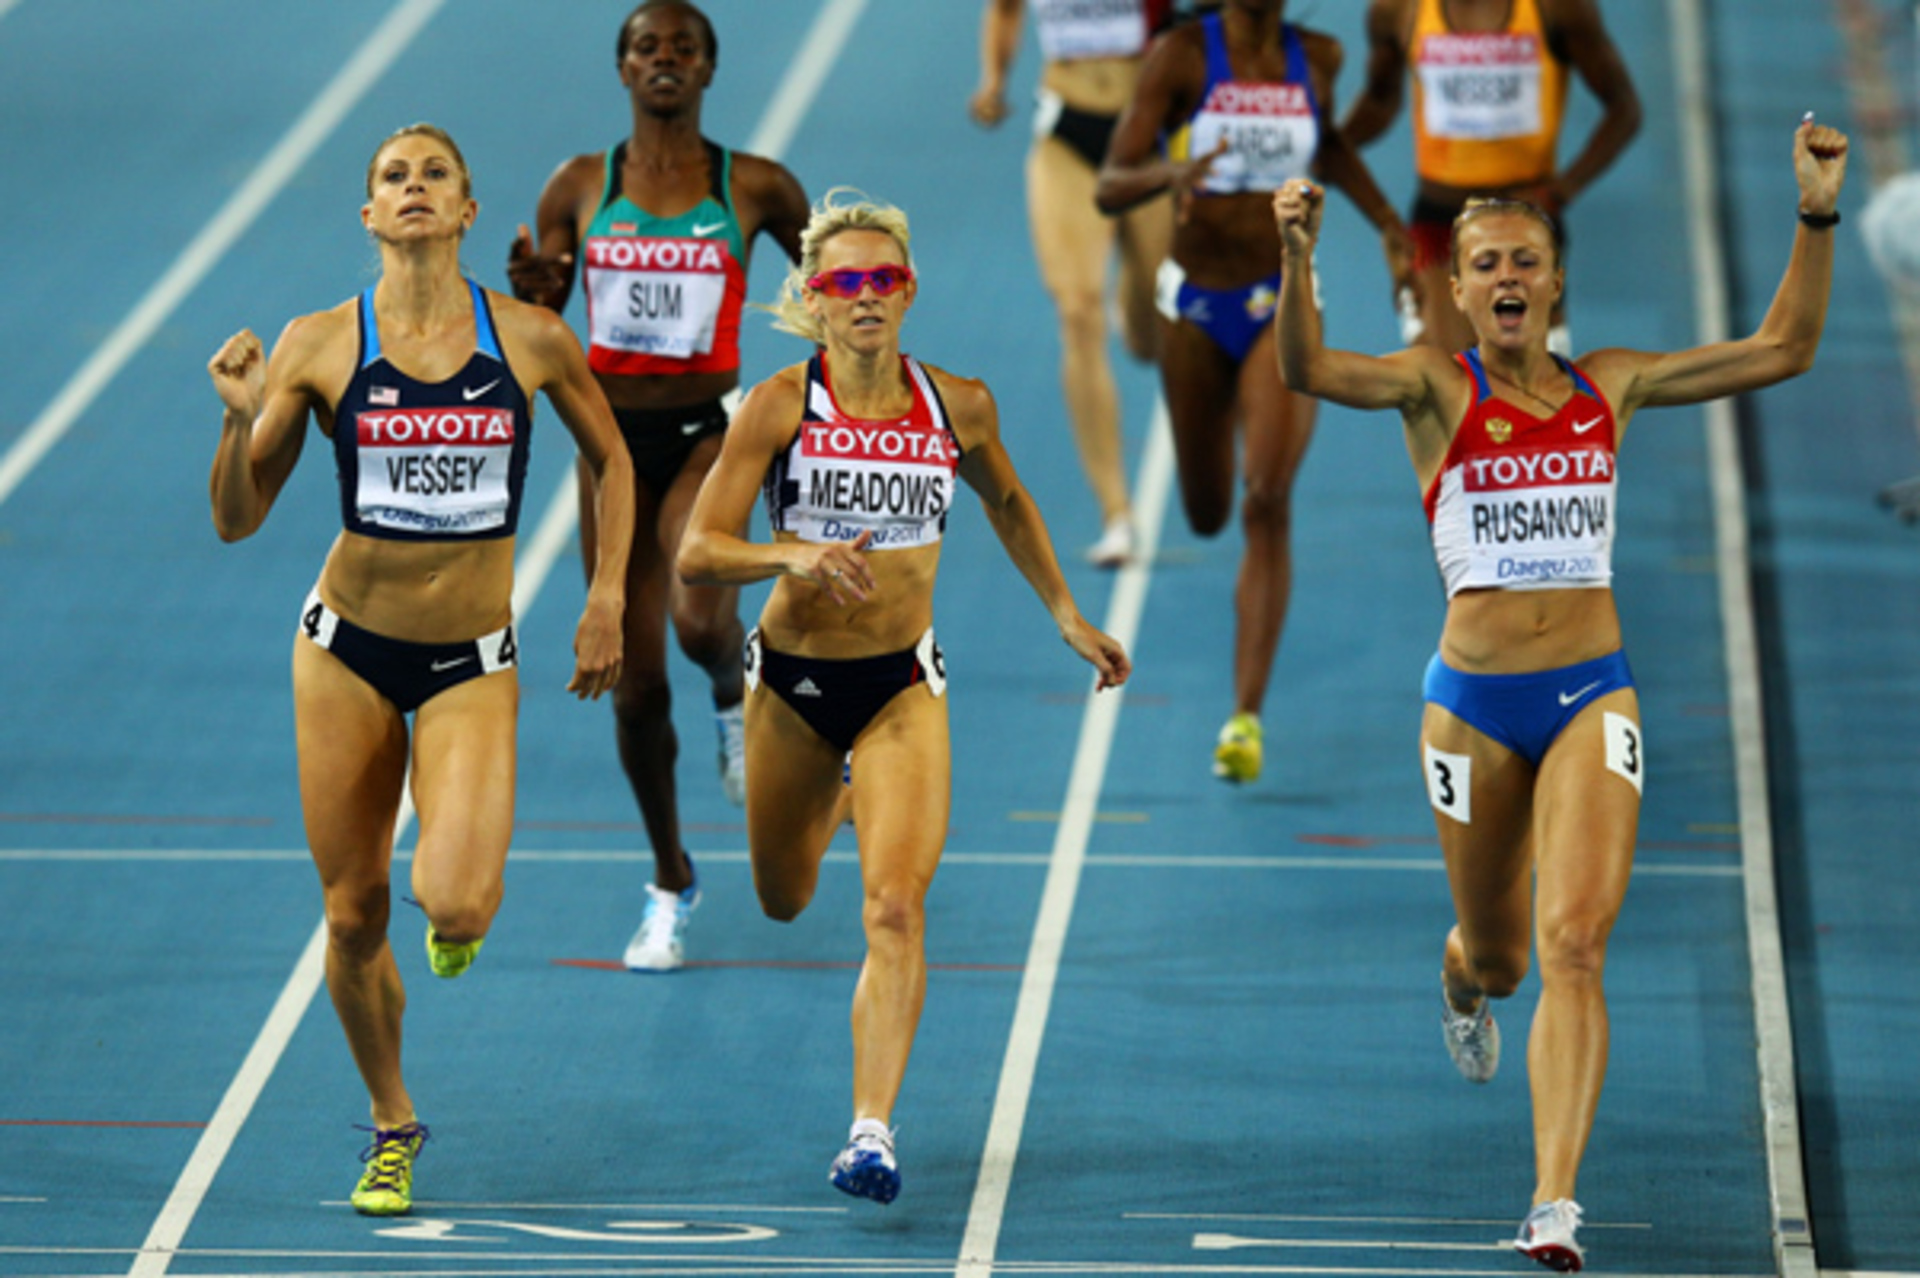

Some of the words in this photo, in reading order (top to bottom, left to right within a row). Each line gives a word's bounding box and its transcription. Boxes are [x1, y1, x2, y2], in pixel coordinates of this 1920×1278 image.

[591, 241, 722, 269] TOYOTA
[628, 281, 682, 320] SUM
[364, 414, 509, 441] TOYOTA
[808, 427, 947, 461] TOYOTA
[386, 455, 487, 496] VESSEY
[1470, 451, 1610, 486] TOYOTA
[810, 468, 944, 517] MEADOWS
[1472, 495, 1608, 544] RUSANOVA
[303, 602, 324, 639] 4
[498, 624, 518, 665] 4
[1622, 728, 1638, 775] 3
[1434, 760, 1455, 807] 3
